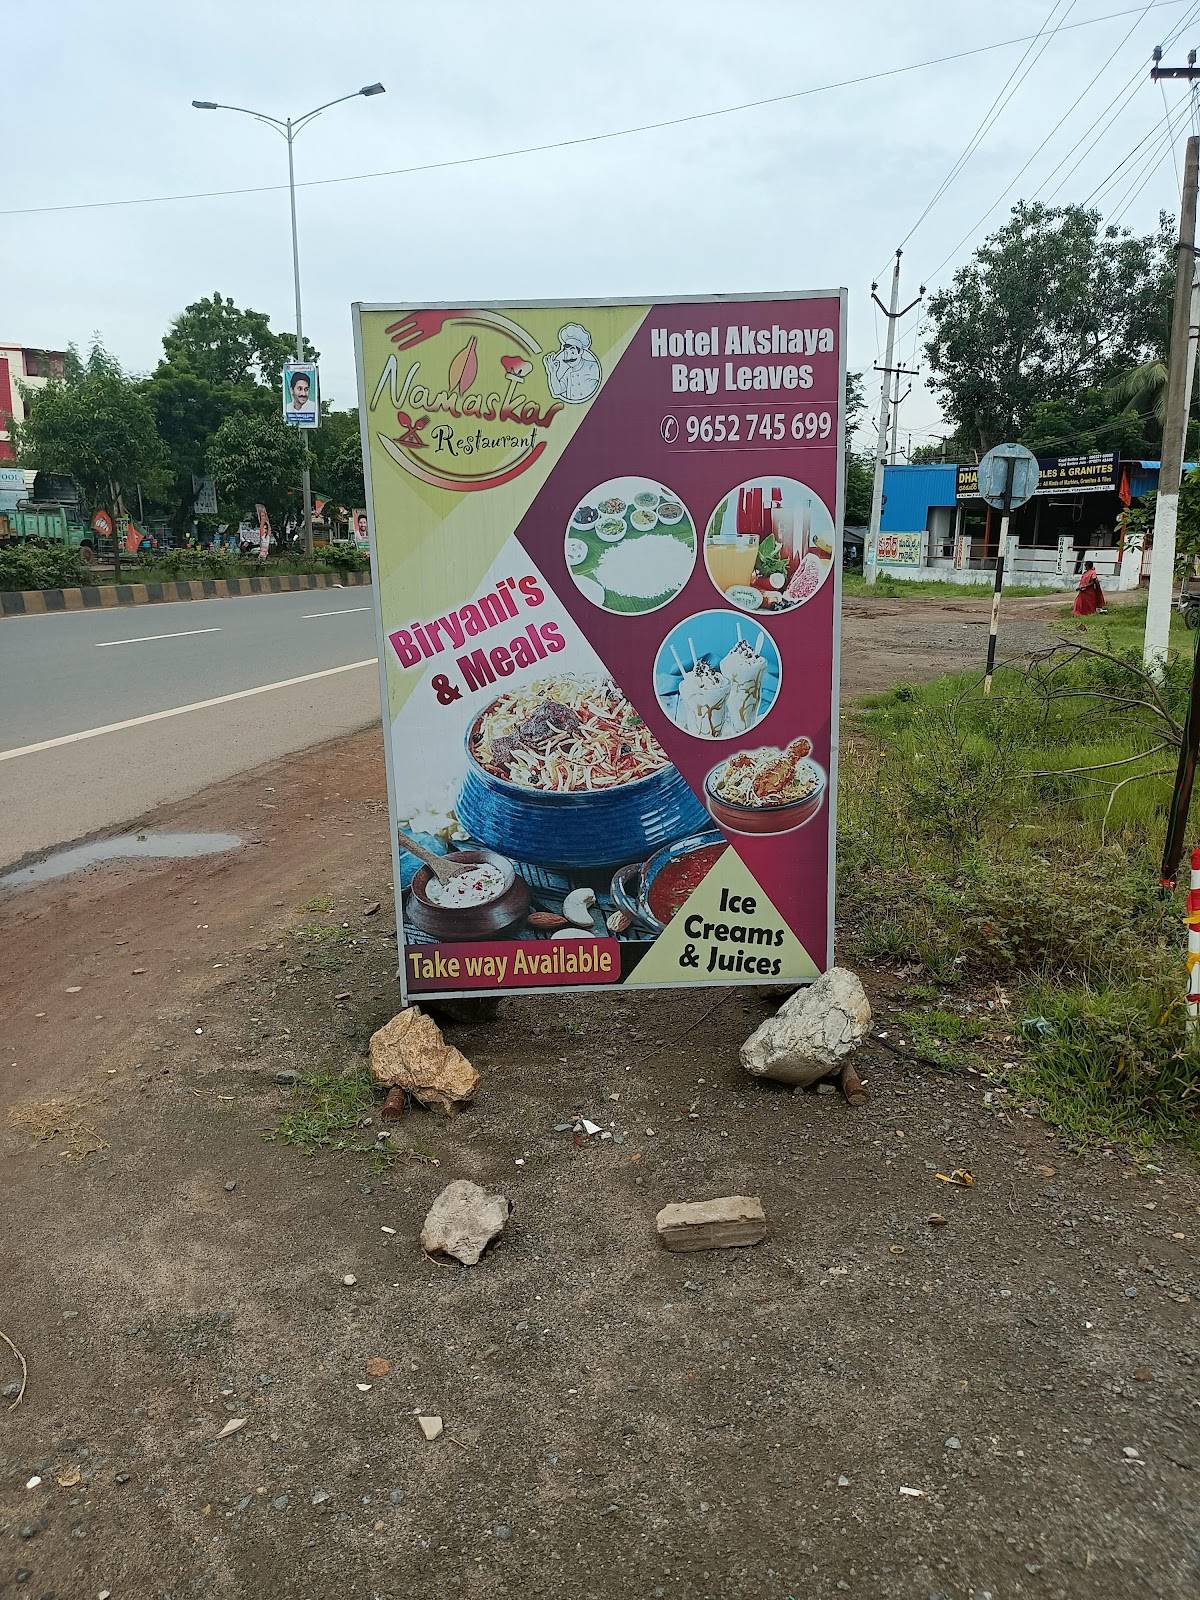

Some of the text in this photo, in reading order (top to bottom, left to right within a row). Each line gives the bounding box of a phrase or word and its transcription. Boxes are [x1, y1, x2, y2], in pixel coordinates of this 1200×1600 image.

[651, 324, 834, 357] Hotel Akshaya
[369, 353, 565, 428] Namaskar
[671, 362, 814, 395] Bay Leaves
[431, 424, 539, 456] Restaurant
[686, 411, 832, 443] 9652 745 699
[1060, 468, 1066, 477] &
[1068, 464, 1113, 476] GRANITES
[388, 575, 545, 669] Biryani's
[431, 621, 566, 706] & Meals
[718, 888, 757, 915] Ice
[684, 915, 785, 947] Creams
[408, 946, 612, 983] Take way Available
[678, 944, 782, 976] & Juices
